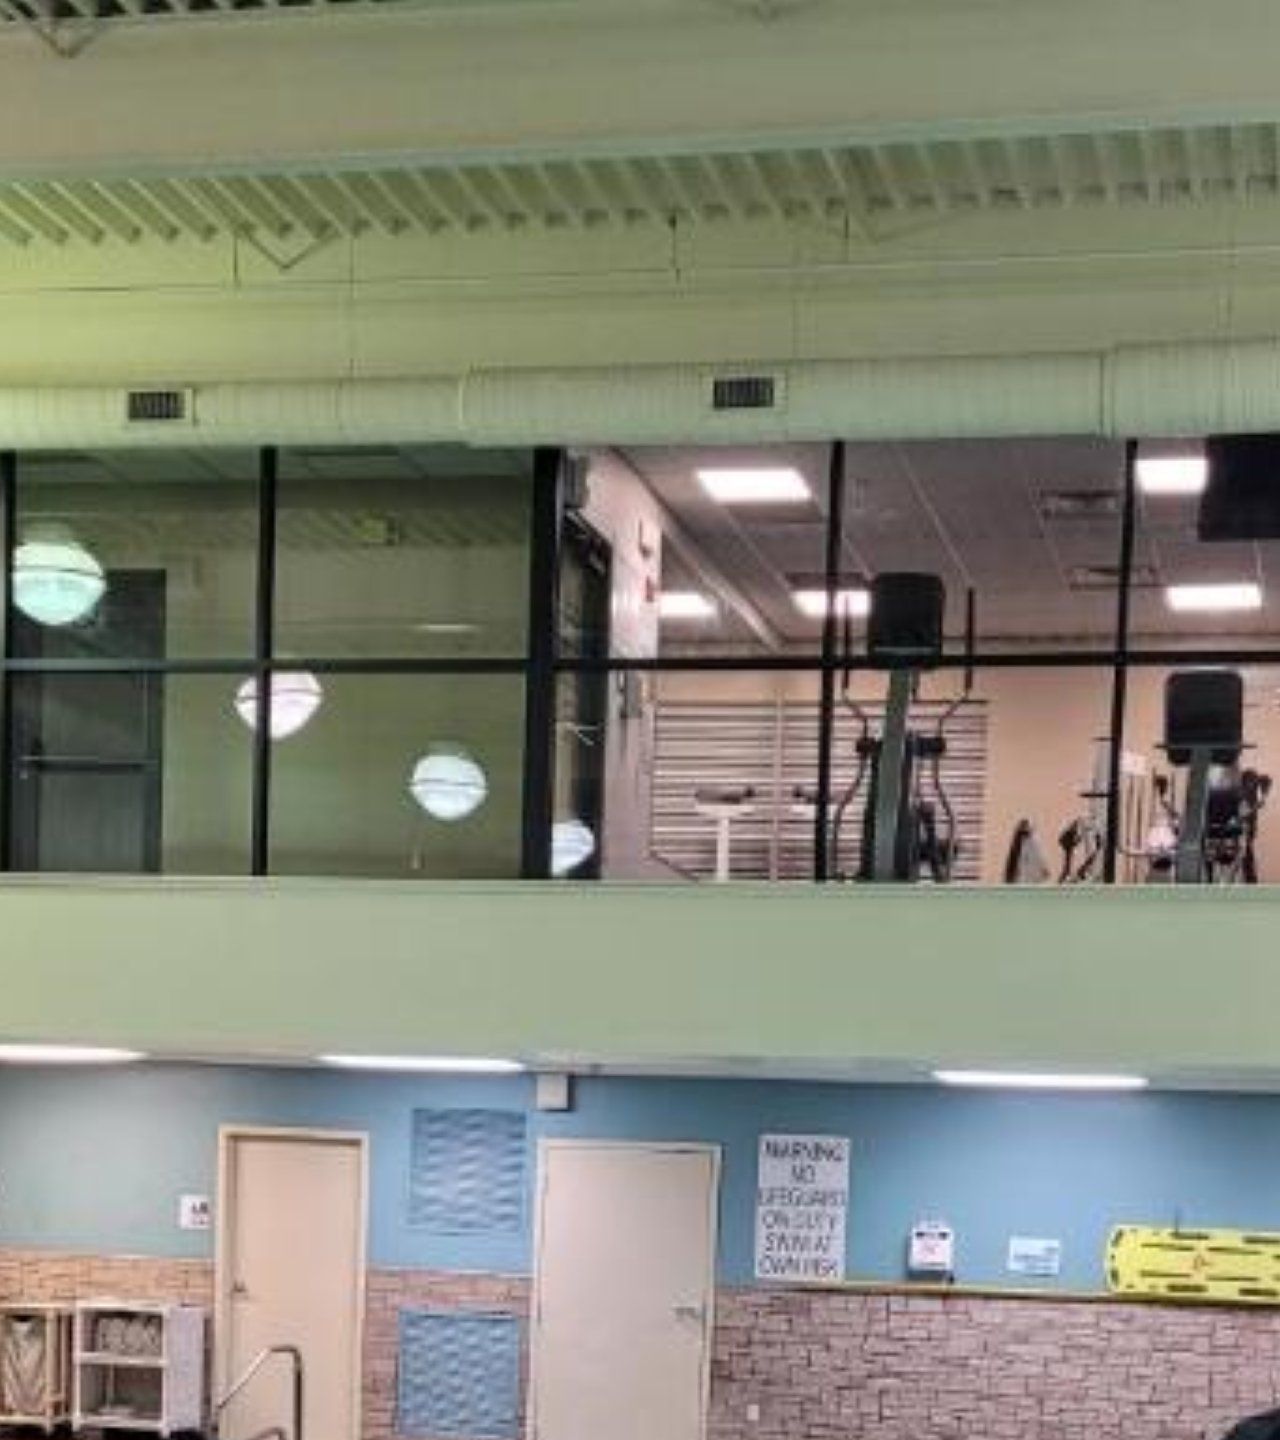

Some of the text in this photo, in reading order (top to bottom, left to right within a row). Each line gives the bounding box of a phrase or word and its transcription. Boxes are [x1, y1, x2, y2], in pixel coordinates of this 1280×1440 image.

[765, 1141, 843, 1162] WARNING
[791, 1163, 816, 1184] NO
[758, 1186, 845, 1207] LIFEGUARD
[763, 1208, 790, 1229] ON
[759, 1254, 802, 1275] OWN
